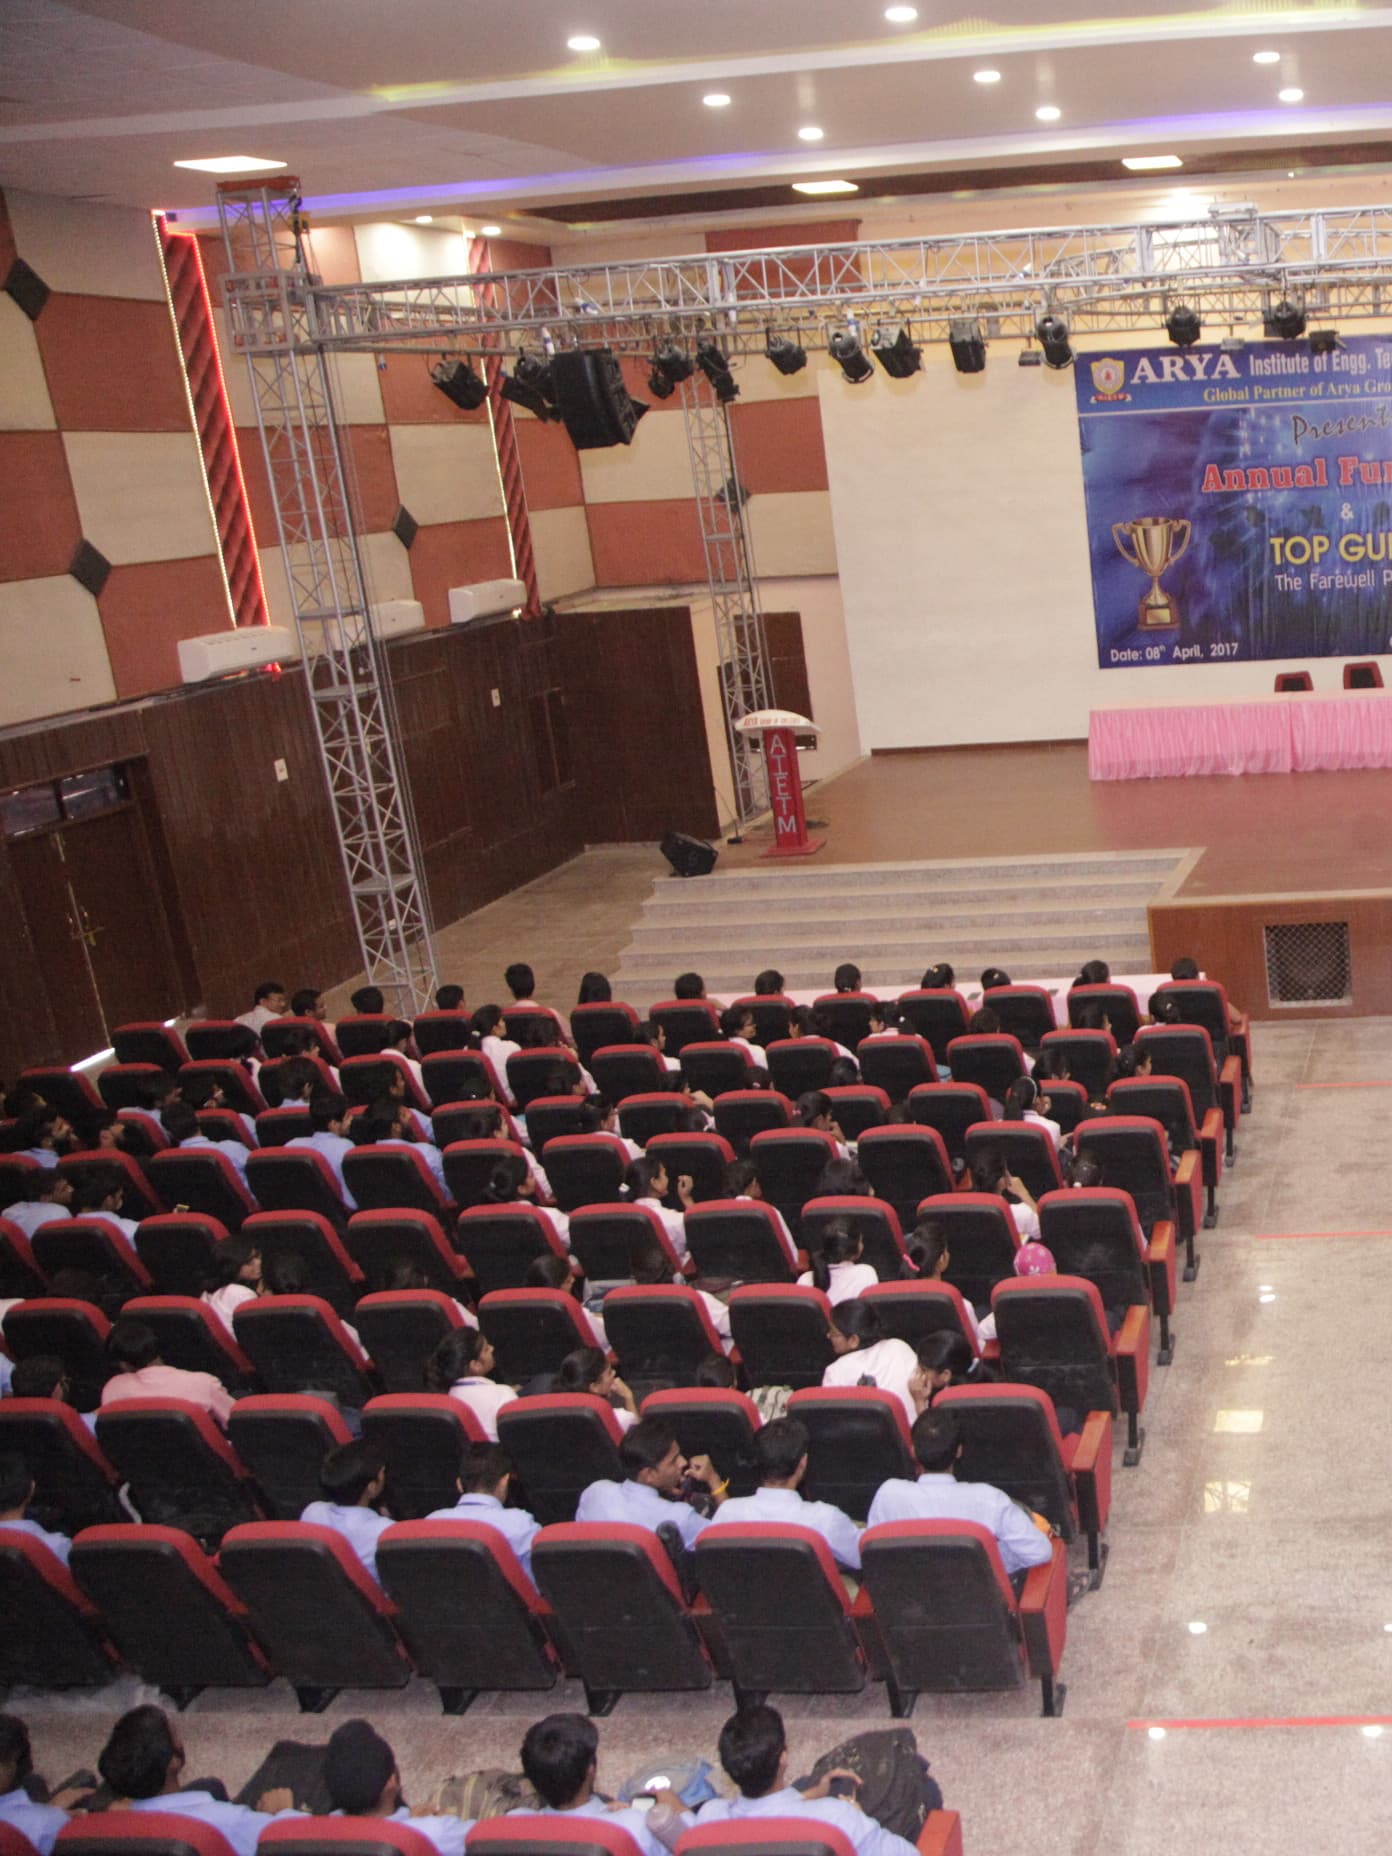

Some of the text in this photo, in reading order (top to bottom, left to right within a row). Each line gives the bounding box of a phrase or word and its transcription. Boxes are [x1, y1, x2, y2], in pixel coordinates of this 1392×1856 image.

[1130, 353, 1241, 384] ARYA
[1249, 353, 1309, 376] Institute
[1314, 352, 1328, 372] of
[1332, 350, 1372, 375] Engg.
[1203, 385, 1249, 402] Global
[1253, 383, 1304, 399] Partner
[1310, 381, 1324, 397] of
[1326, 380, 1361, 396] Arya
[1201, 457, 1328, 493] Annual
[1340, 502, 1354, 520] &
[1270, 535, 1330, 566] TOP
[1275, 572, 1302, 591] The
[1310, 570, 1375, 590] Farewell
[1110, 648, 1143, 662] Date:
[1210, 643, 1239, 657] 2017
